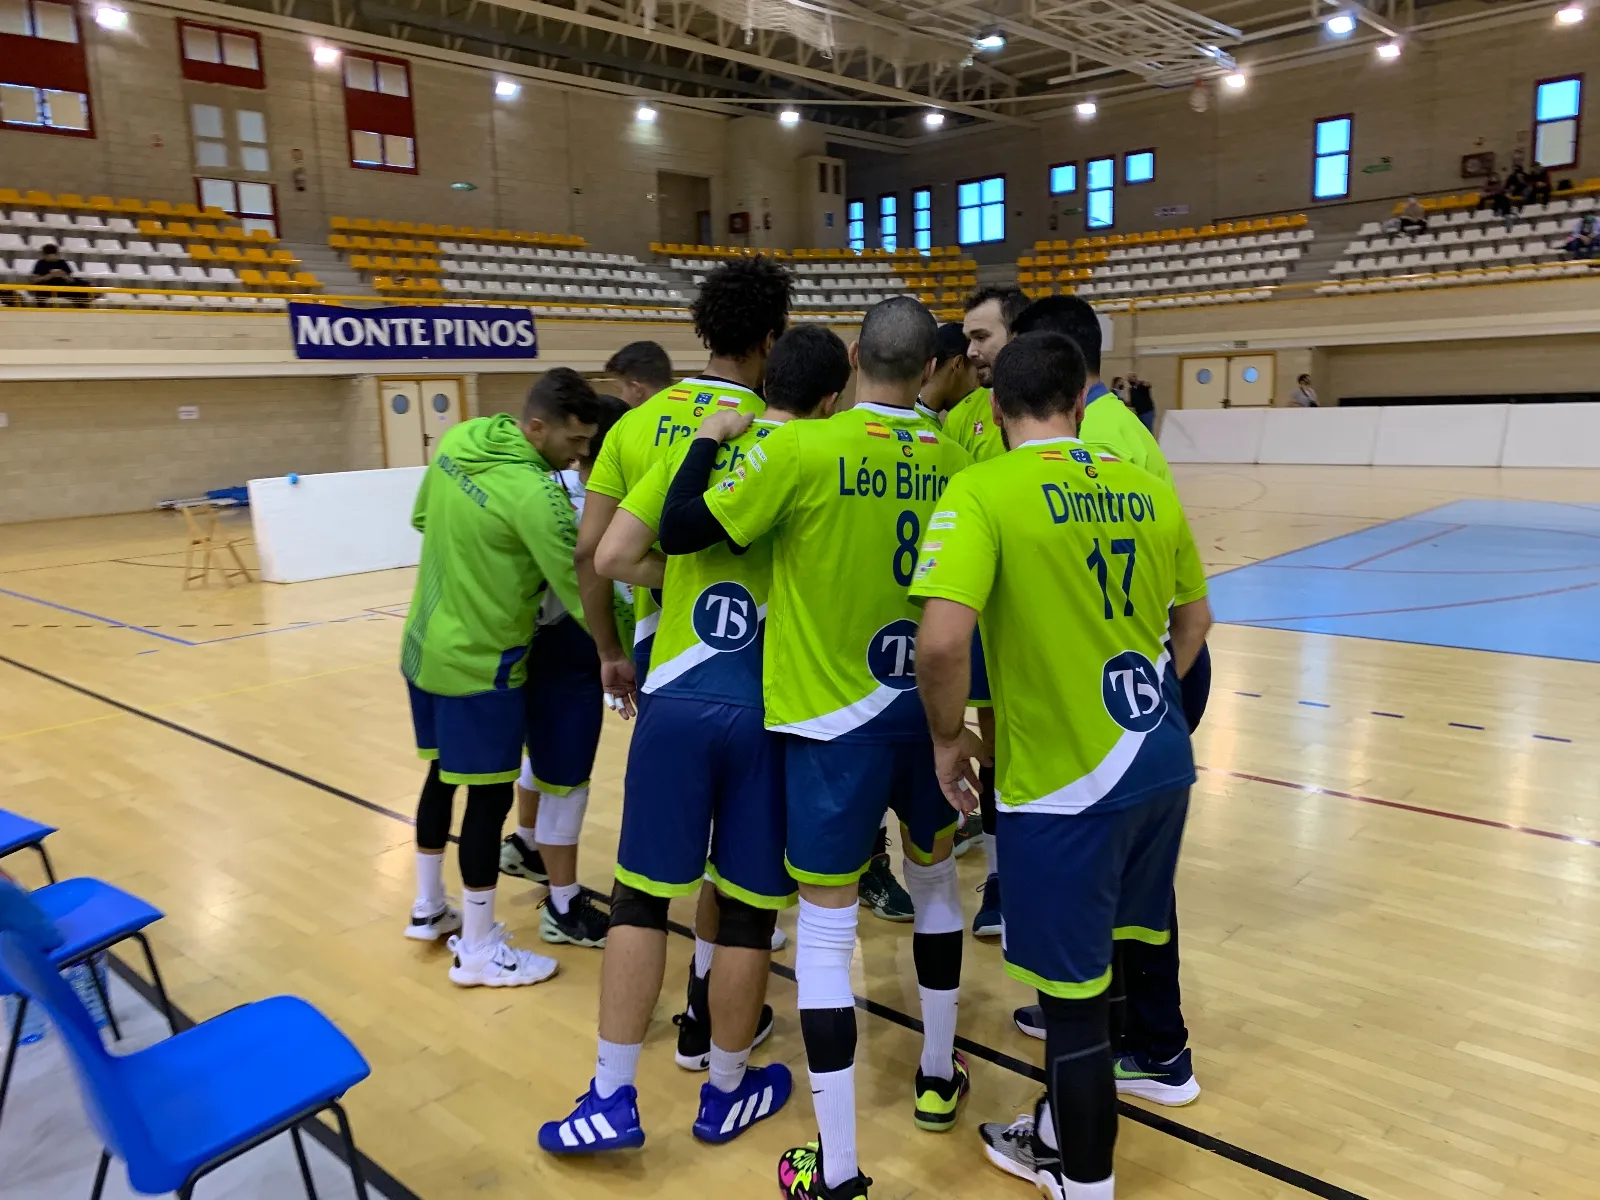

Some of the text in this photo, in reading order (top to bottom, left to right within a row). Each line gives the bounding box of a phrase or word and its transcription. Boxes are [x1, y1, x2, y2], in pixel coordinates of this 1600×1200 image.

[297, 315, 534, 347] MONTE PINOS
[654, 415, 698, 447] Fra
[839, 456, 887, 498] Léo
[1041, 482, 1156, 525] Dimitrov
[892, 510, 920, 587] 8
[1086, 538, 1137, 620] 17
